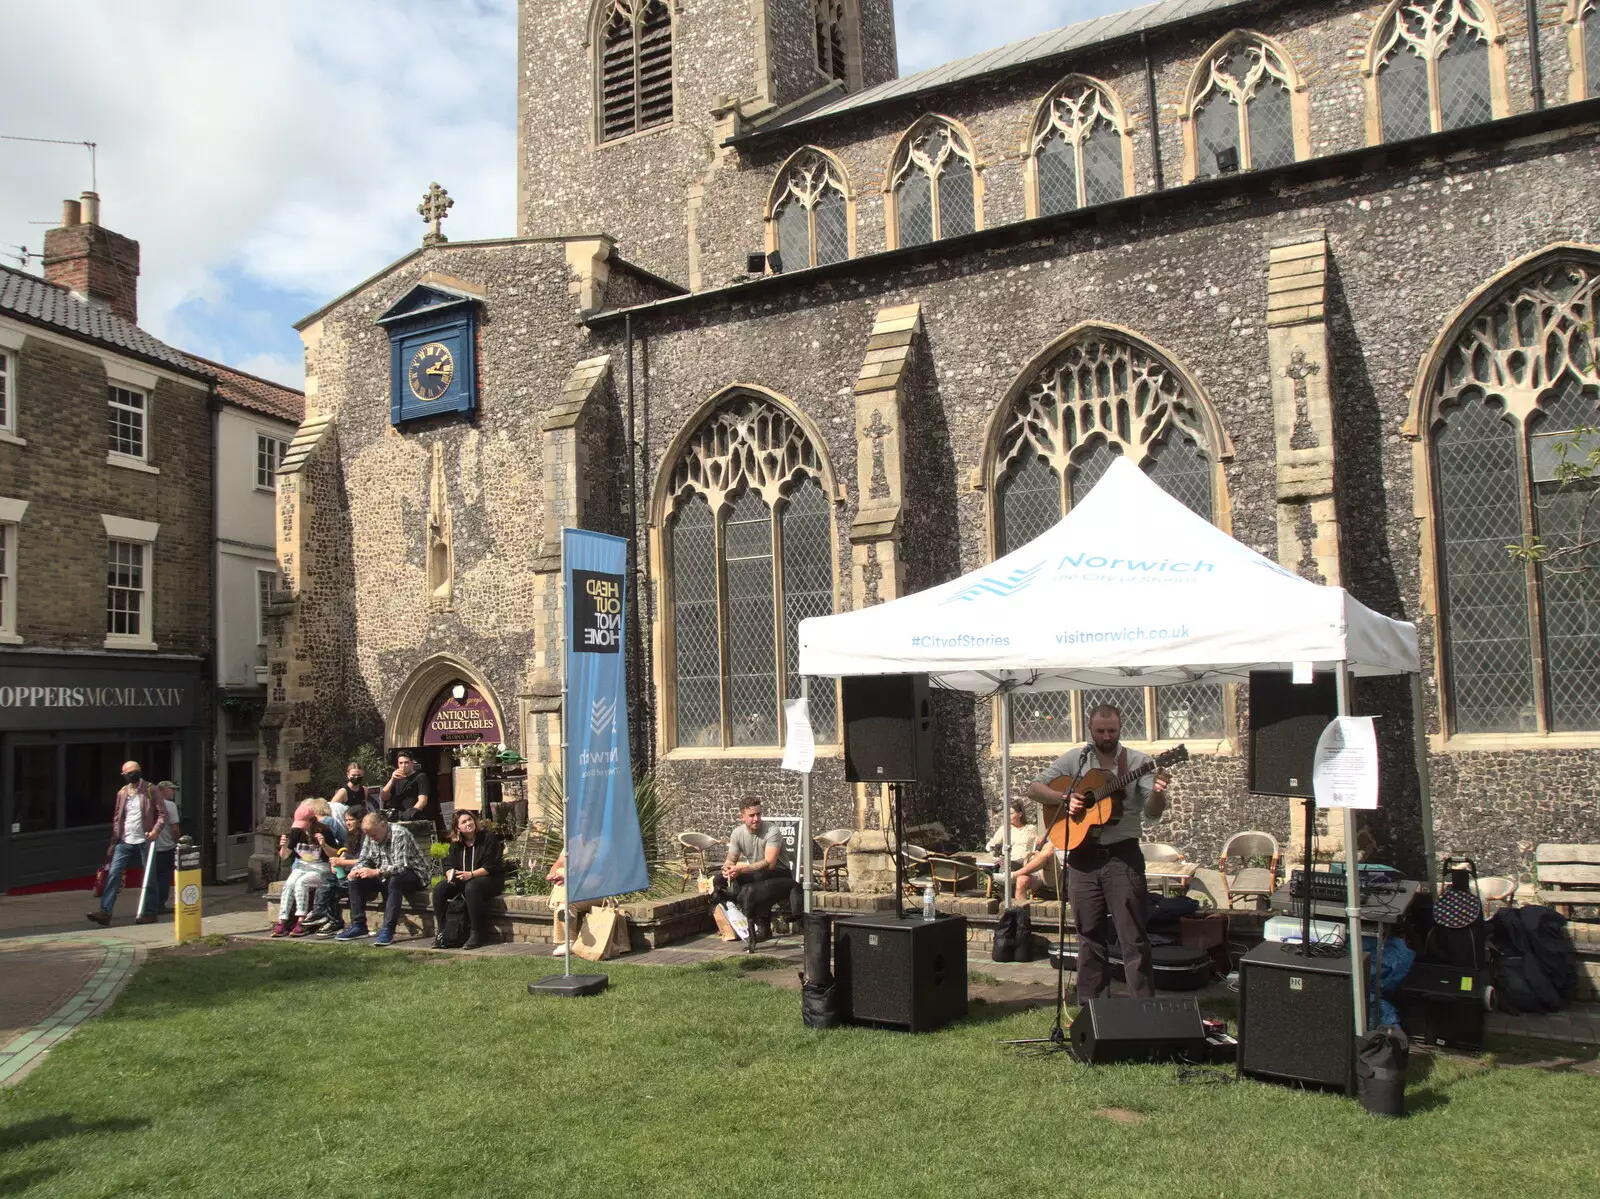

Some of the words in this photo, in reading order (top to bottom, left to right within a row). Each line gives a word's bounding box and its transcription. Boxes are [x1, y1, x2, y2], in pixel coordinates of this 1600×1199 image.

[1057, 552, 1214, 572] Norwich
[1055, 624, 1189, 645] visitnorwich.co.uk
[911, 635, 1010, 649] #CityofStories
[437, 710, 480, 721] ANTIQUES
[431, 720, 494, 730] COLLECTABLES
[779, 826, 796, 836] STA
